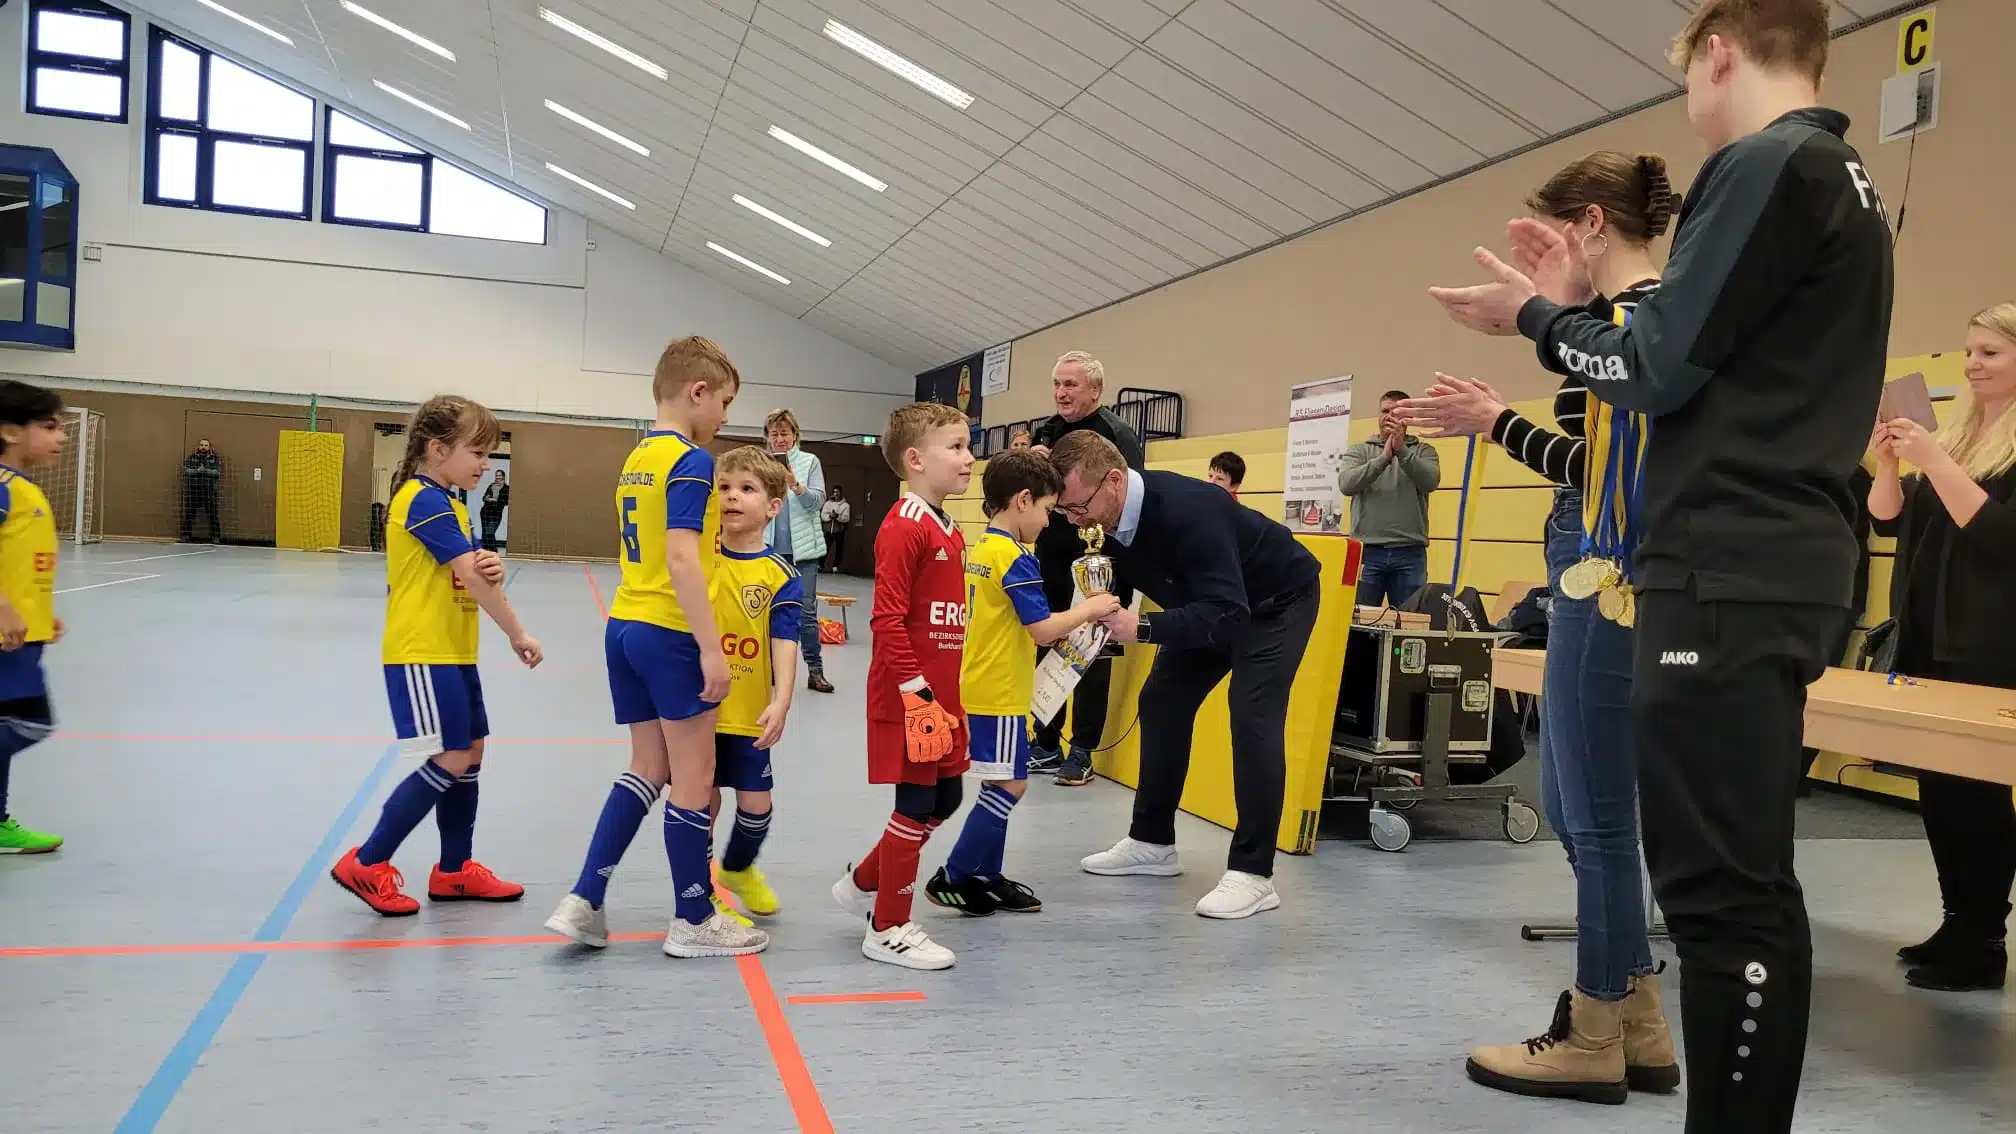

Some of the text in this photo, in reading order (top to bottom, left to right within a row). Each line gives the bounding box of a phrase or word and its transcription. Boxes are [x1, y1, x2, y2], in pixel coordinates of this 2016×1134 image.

[1904, 18, 1928, 66] C
[622, 496, 641, 564] 6
[1660, 651, 1699, 665] JAKO
